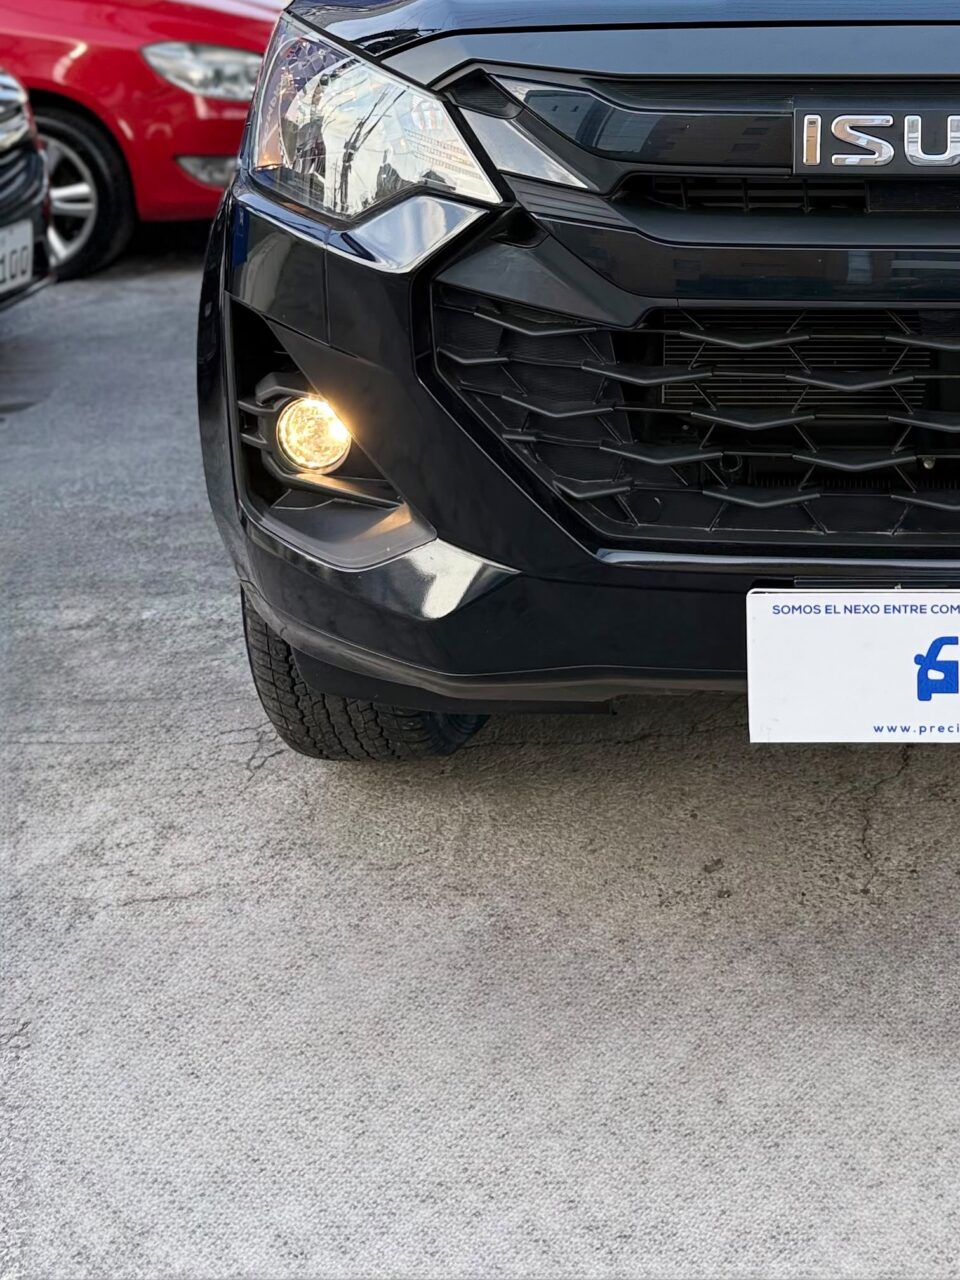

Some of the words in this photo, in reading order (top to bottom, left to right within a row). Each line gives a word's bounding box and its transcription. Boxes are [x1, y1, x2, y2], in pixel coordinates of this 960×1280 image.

[772, 604, 821, 615] SOMOS
[824, 604, 841, 615] EL
[843, 604, 880, 615] NEXO
[883, 604, 928, 615] ENTRE
